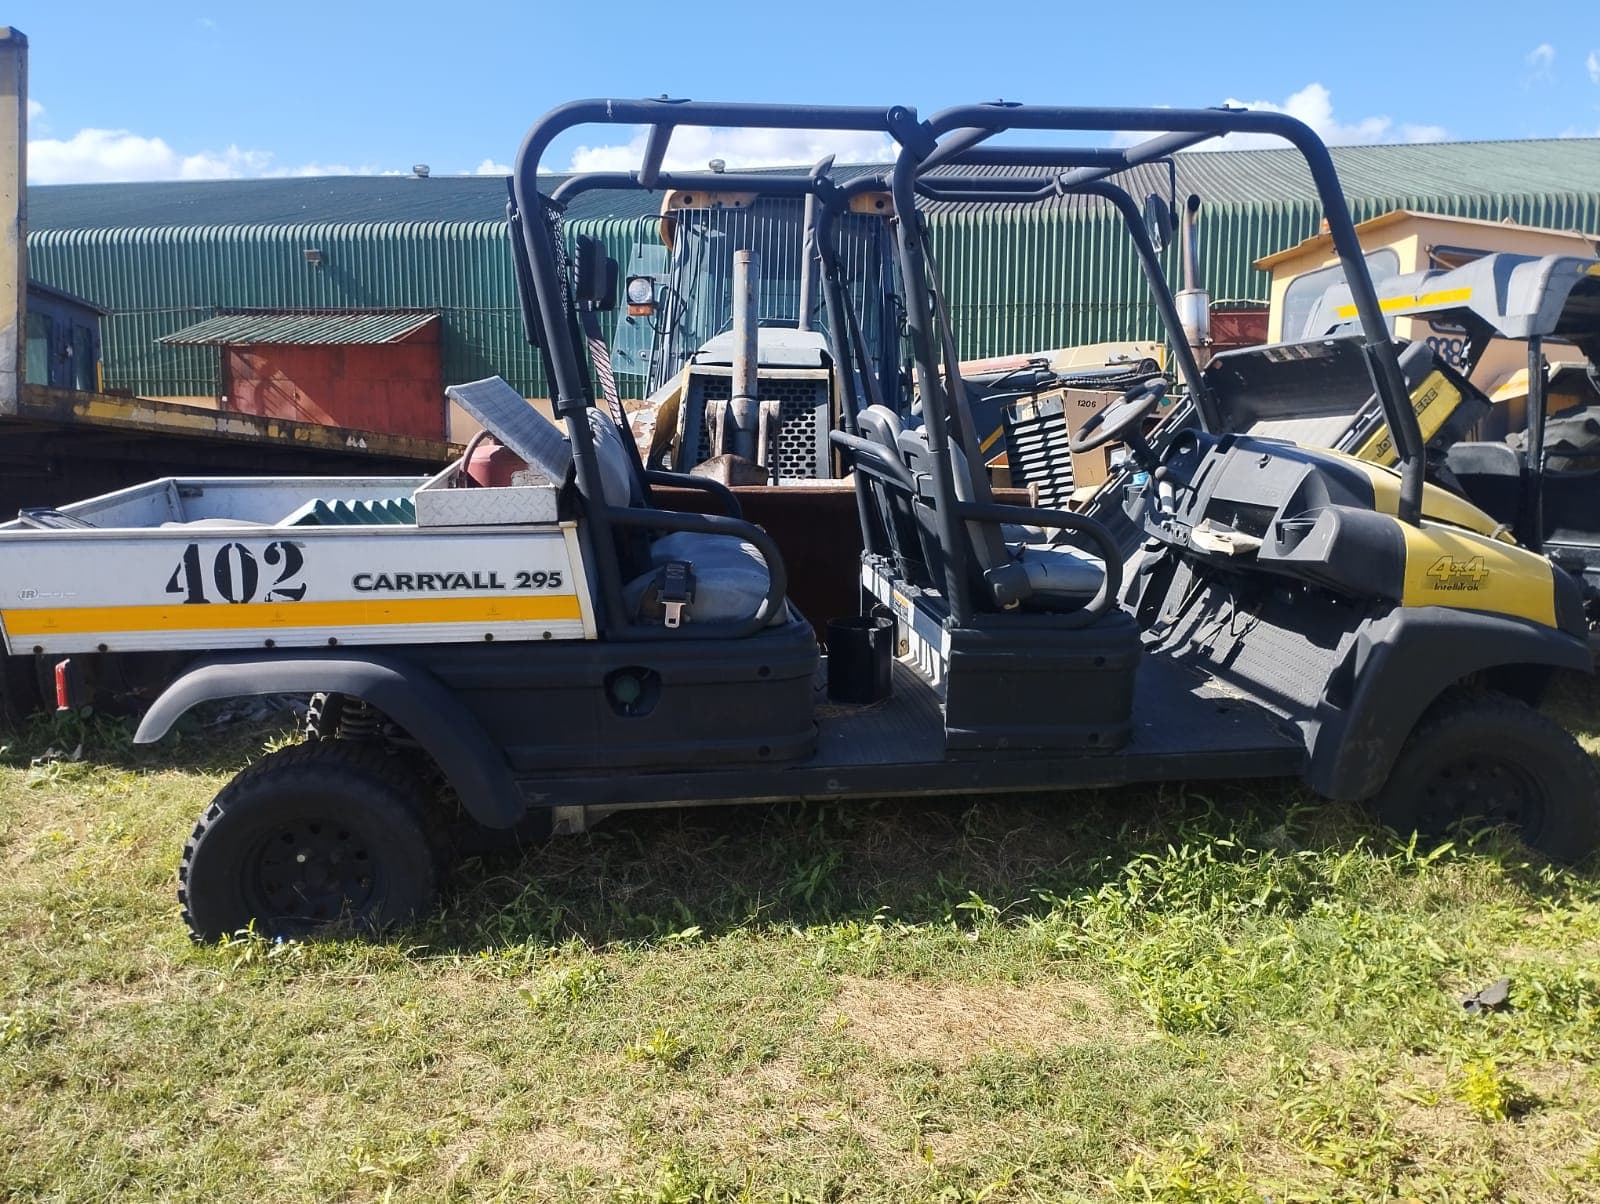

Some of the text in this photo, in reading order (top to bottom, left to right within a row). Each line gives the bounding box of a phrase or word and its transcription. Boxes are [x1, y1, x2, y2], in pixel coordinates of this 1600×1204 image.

[165, 541, 307, 604] 402
[352, 570, 564, 592] CARRYALL 295
